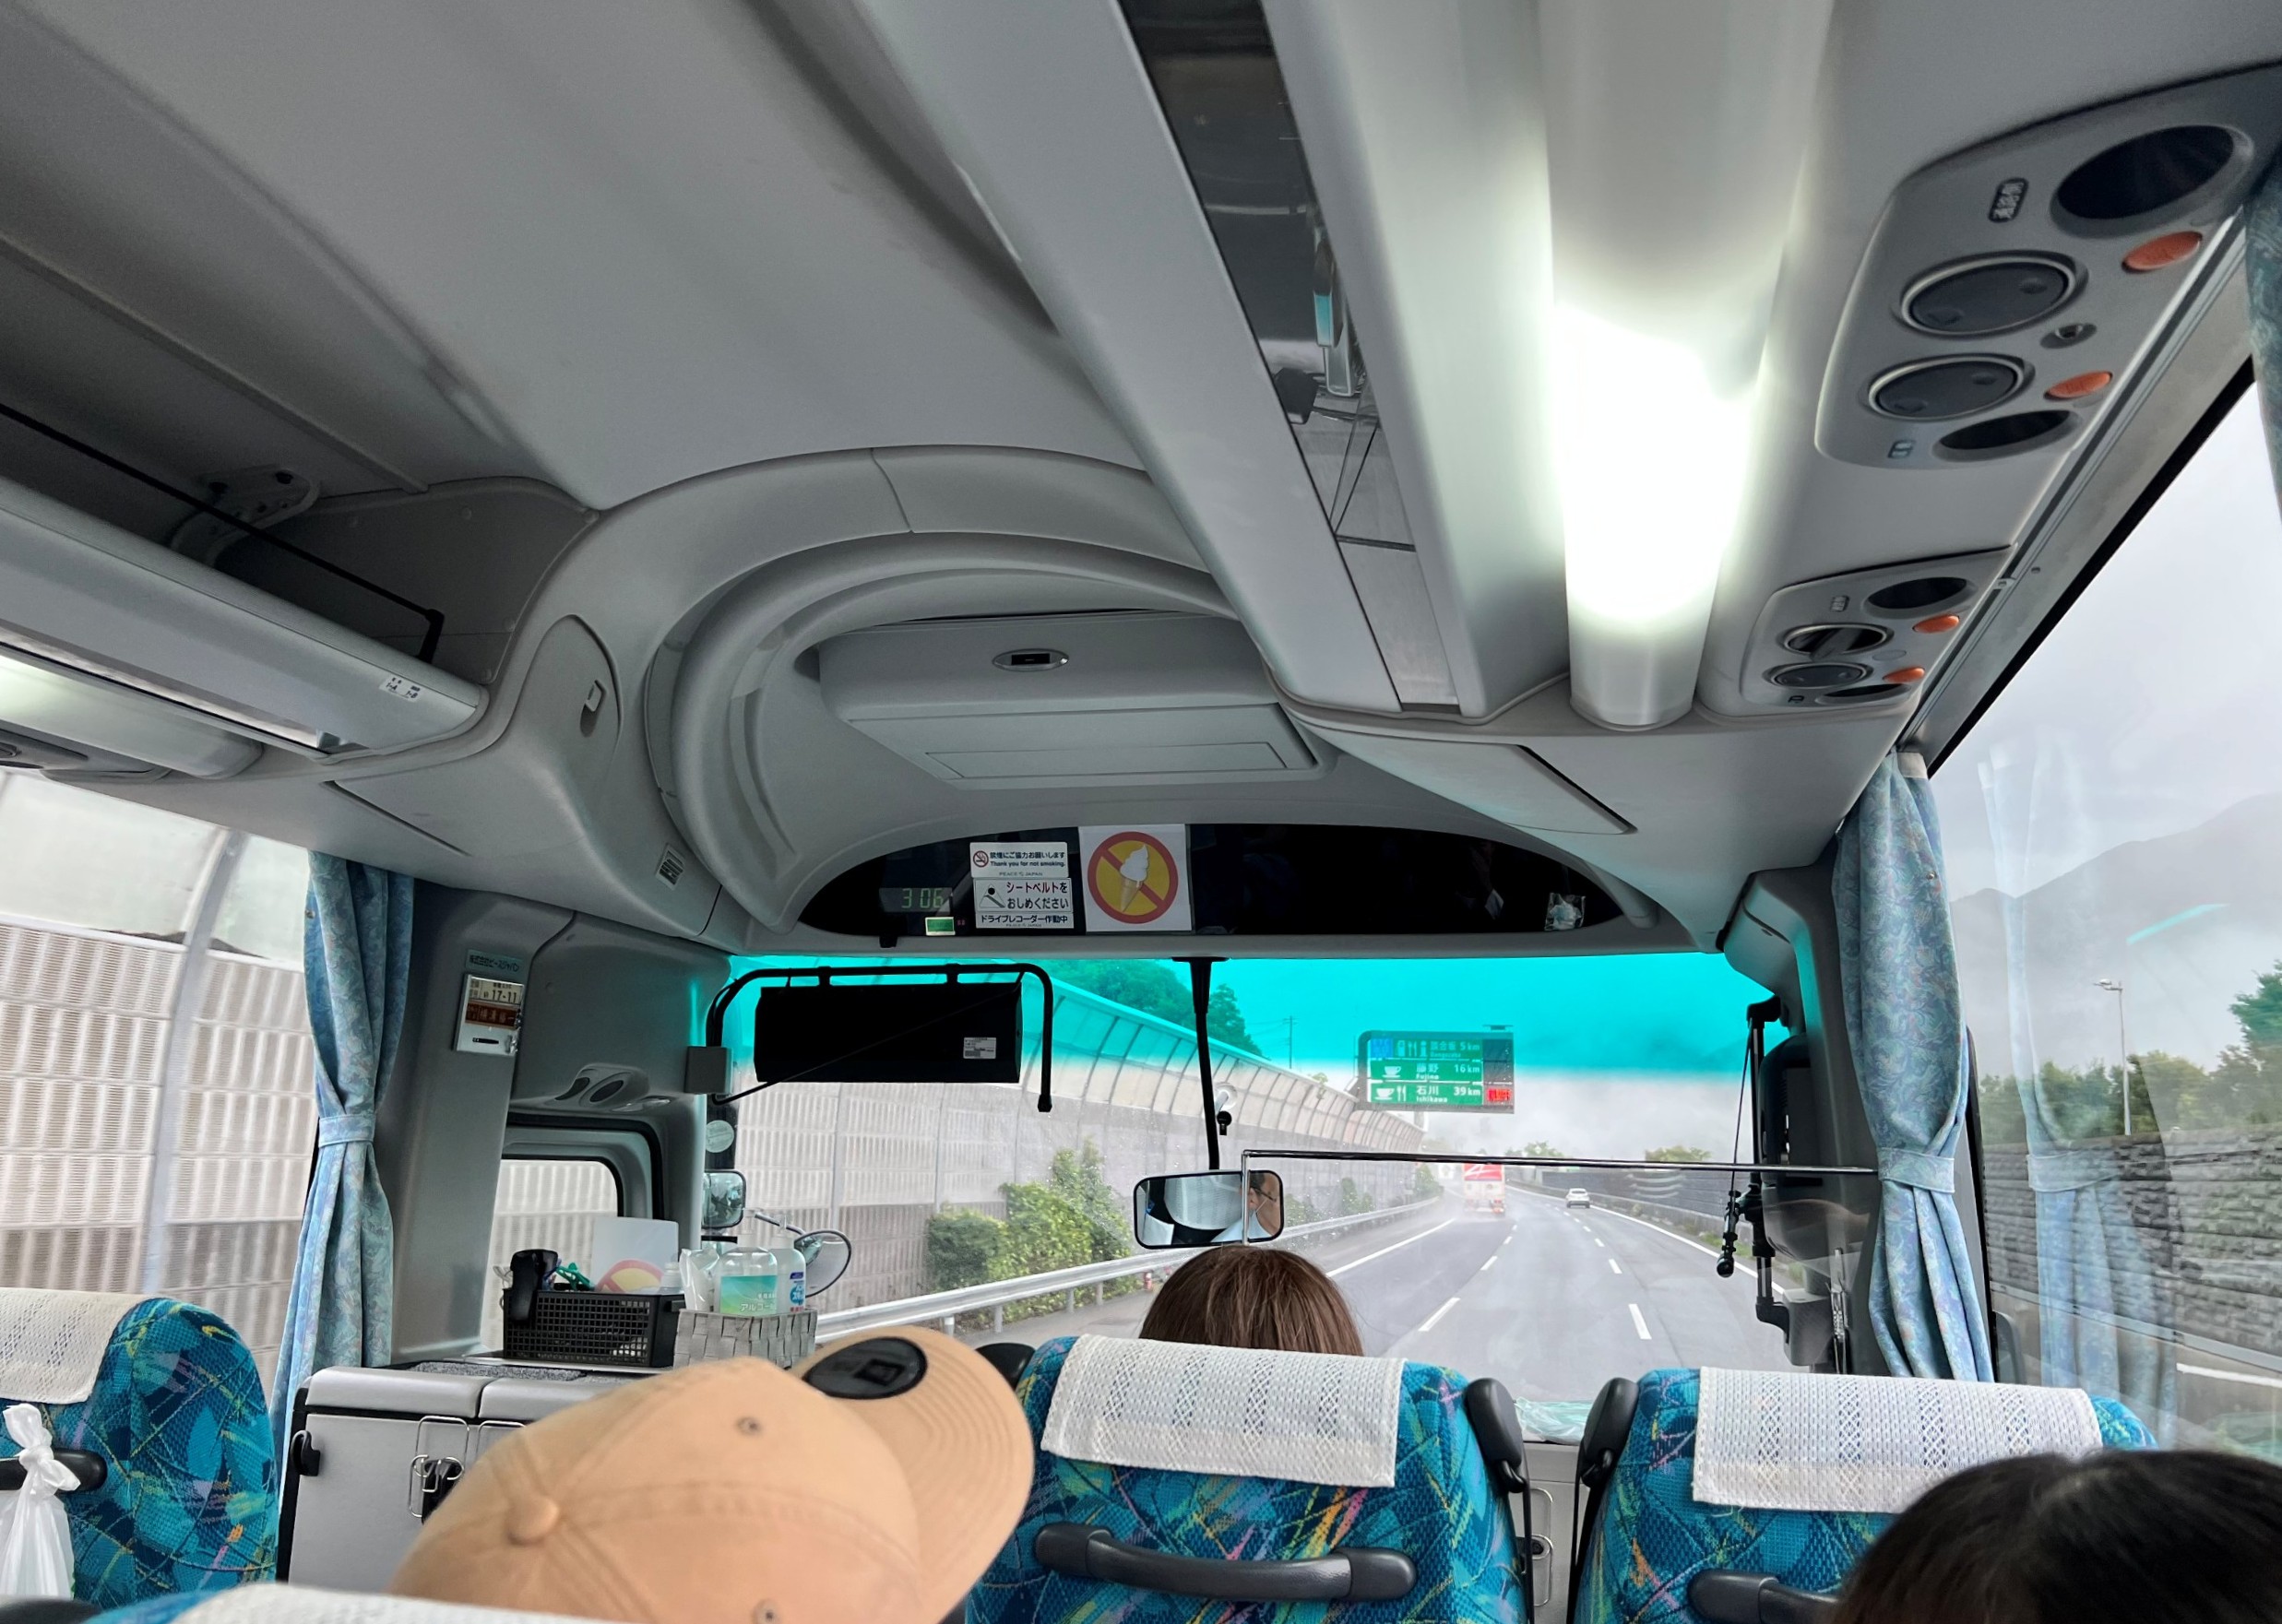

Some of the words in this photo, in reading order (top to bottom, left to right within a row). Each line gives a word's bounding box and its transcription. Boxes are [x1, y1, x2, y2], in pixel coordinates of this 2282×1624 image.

[1006, 882, 1068, 894] シートベルトを
[1007, 897, 1069, 909] おしめください
[981, 915, 1068, 923] ドライブレコーダー作動中
[1460, 1041, 1467, 1050] 5
[1468, 1042, 1480, 1050] km
[1454, 1063, 1467, 1073] 16
[1468, 1064, 1480, 1073] km
[1416, 1085, 1439, 1096] 石川
[1453, 1086, 1467, 1096] 39
[1468, 1087, 1480, 1096] km
